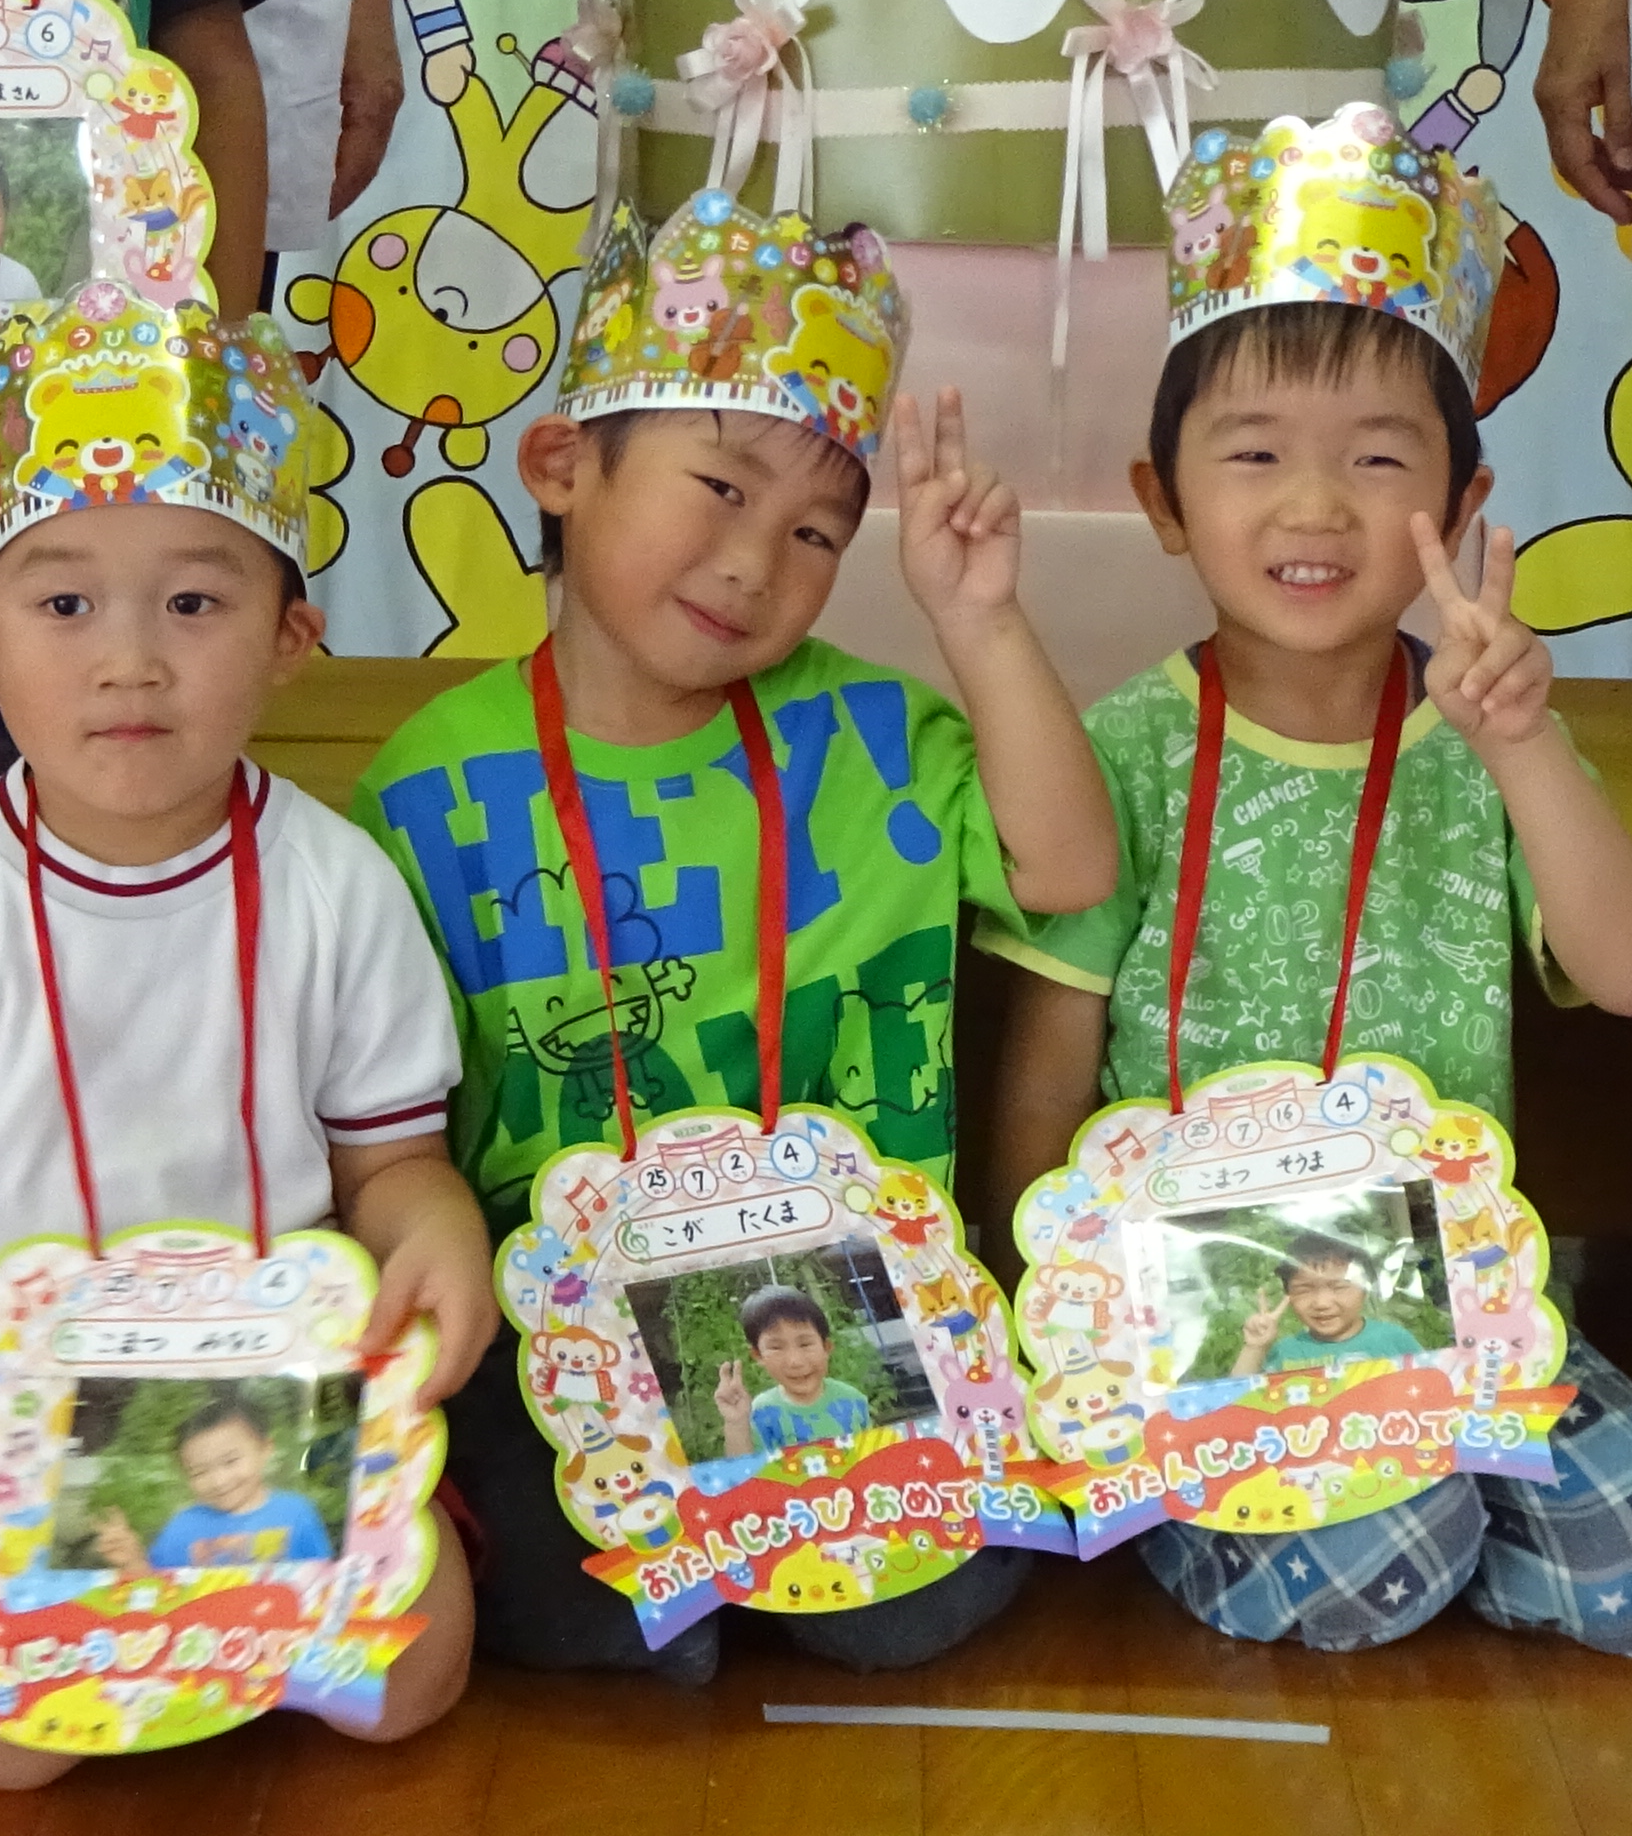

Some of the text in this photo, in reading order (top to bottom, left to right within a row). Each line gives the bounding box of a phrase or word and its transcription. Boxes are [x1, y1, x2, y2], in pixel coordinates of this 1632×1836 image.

[40, 22, 55, 42] 6
[1233, 771, 1319, 826] CHANGE!
[380, 680, 942, 994] HEY!
[1265, 899, 1322, 946] 02
[1139, 1002, 1230, 1050] CHNGE!
[1189, 1121, 1211, 1139] 25
[1237, 1123, 1250, 1140] 7
[1336, 1091, 1356, 1112] 4
[646, 1142, 800, 1192] 25 7 2 4
[1276, 1150, 1325, 1175] そうま
[662, 1200, 799, 1247] こが たくま
[1087, 1408, 1527, 1515] おたんじょうび おめでとう
[638, 1479, 1044, 1605] おたんじょうび おめでとう
